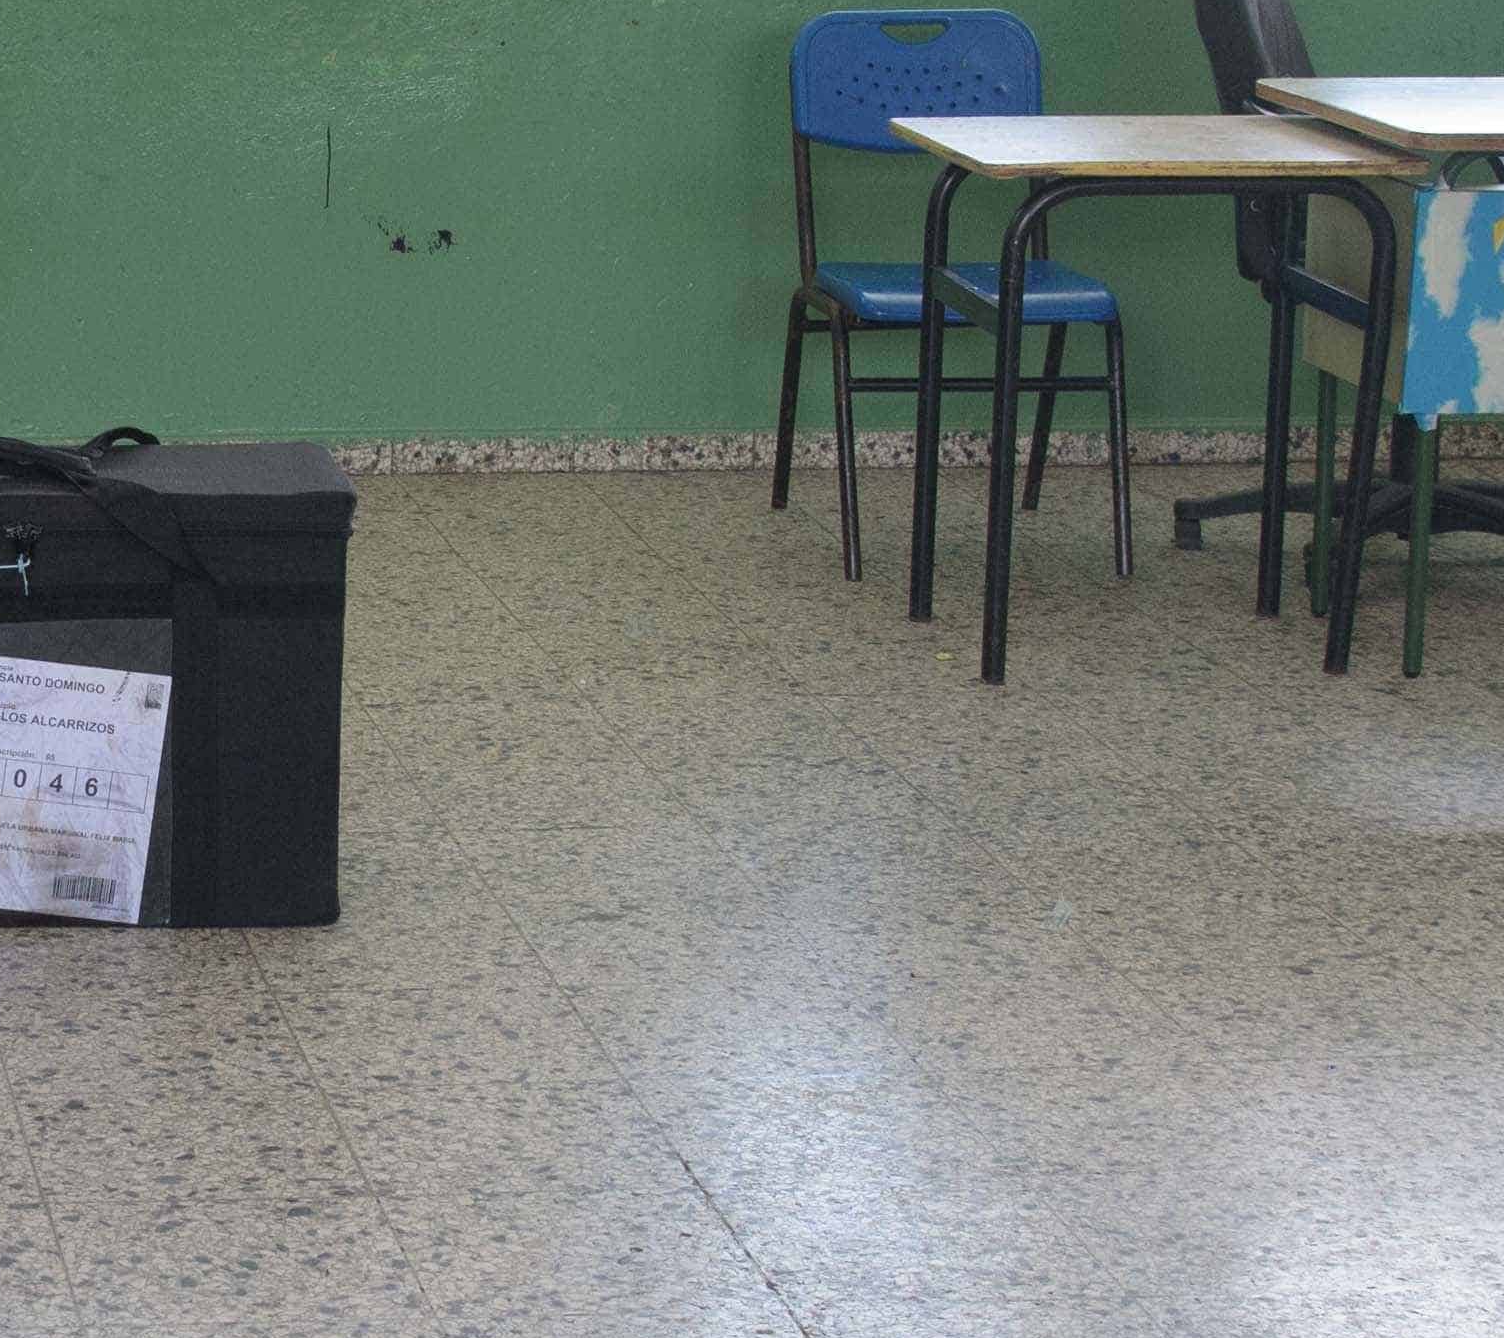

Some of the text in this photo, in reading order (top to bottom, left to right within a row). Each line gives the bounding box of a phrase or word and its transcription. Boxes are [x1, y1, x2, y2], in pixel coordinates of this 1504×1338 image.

[44, 677, 106, 695] DOMINGO
[31, 715, 116, 735] ALCARRIZOS
[13, 768, 27, 788] 0
[49, 773, 63, 793] 4
[84, 777, 99, 797] 6
